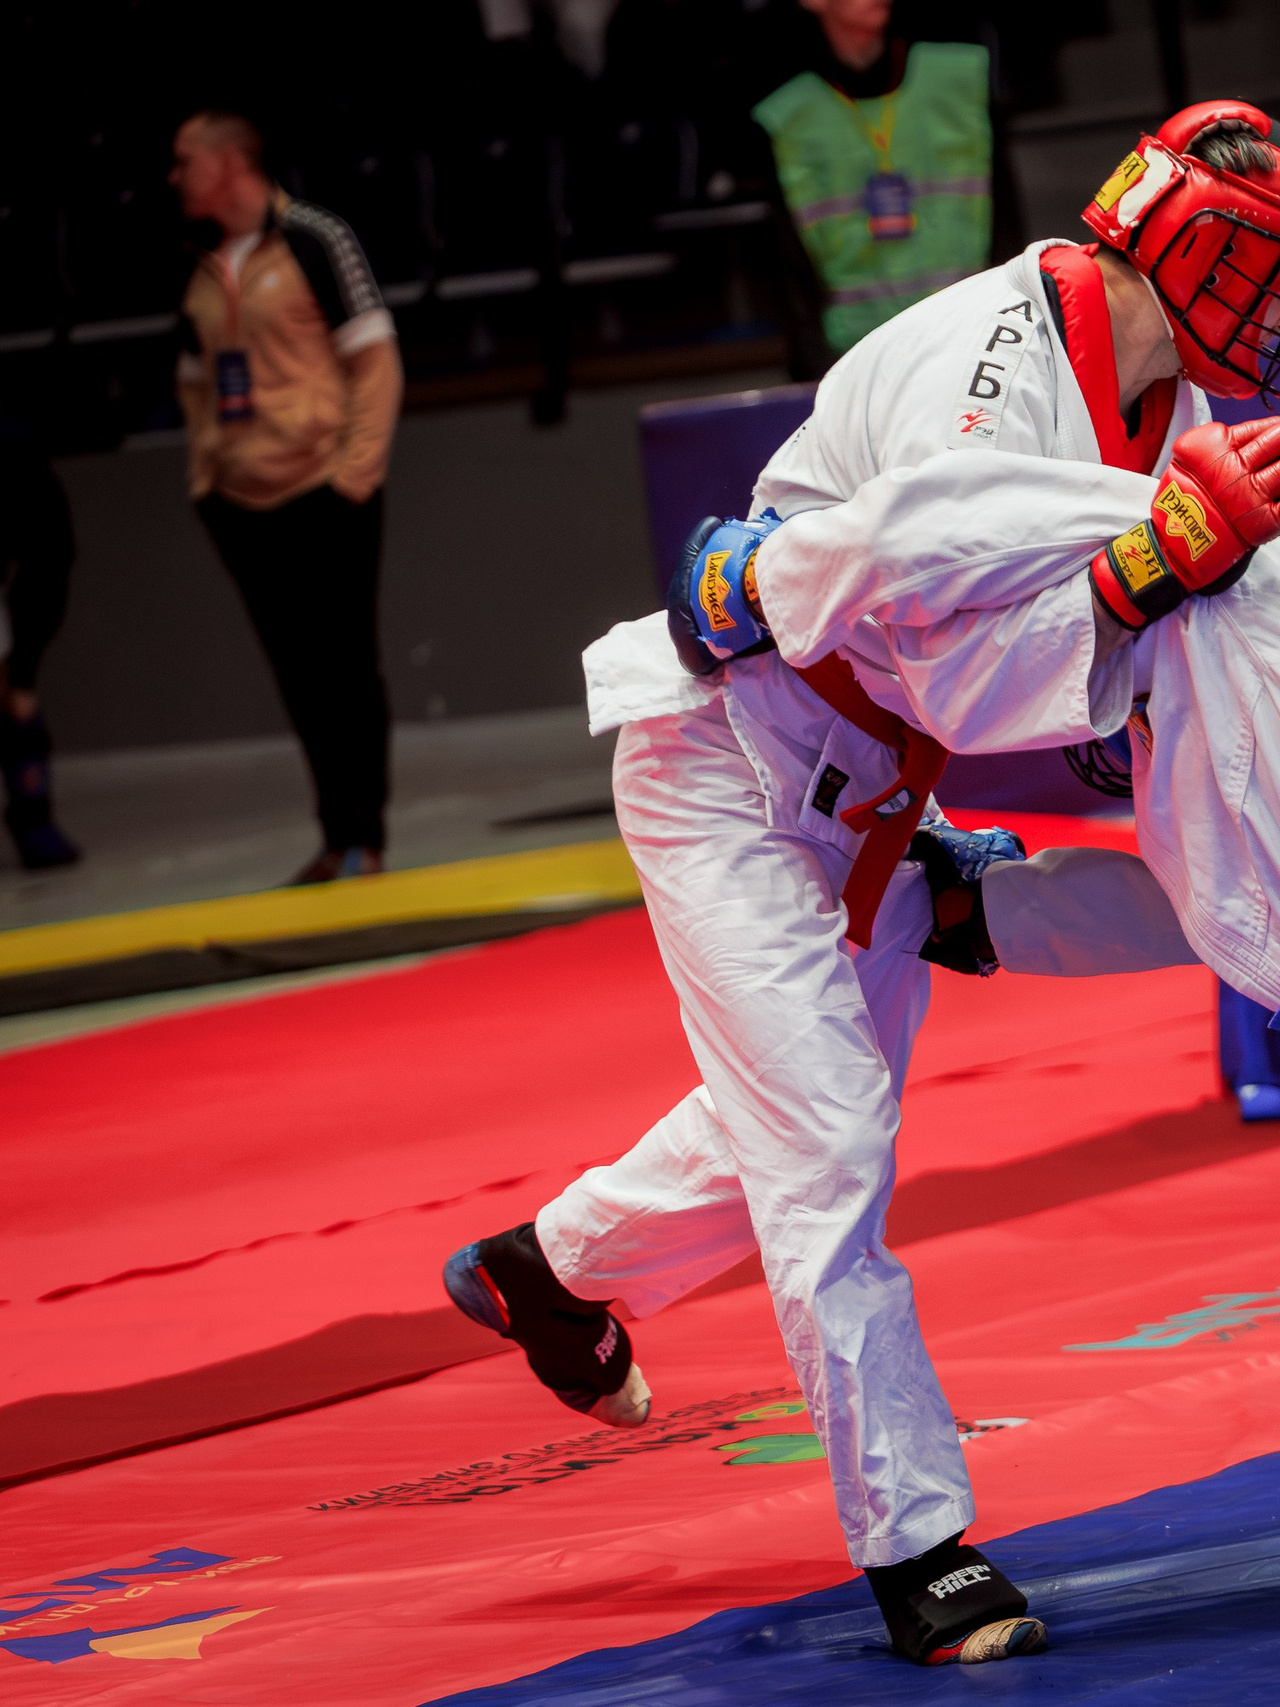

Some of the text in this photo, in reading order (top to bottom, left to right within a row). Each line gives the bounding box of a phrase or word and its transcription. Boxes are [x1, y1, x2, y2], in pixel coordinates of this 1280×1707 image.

[968, 300, 1033, 399] АРБ
[1160, 489, 1211, 552] РЭЙ-СПОРТ
[1116, 544, 1134, 578] СПОРТ
[927, 1564, 991, 1592] GREEN
[934, 1572, 991, 1599] HILL
